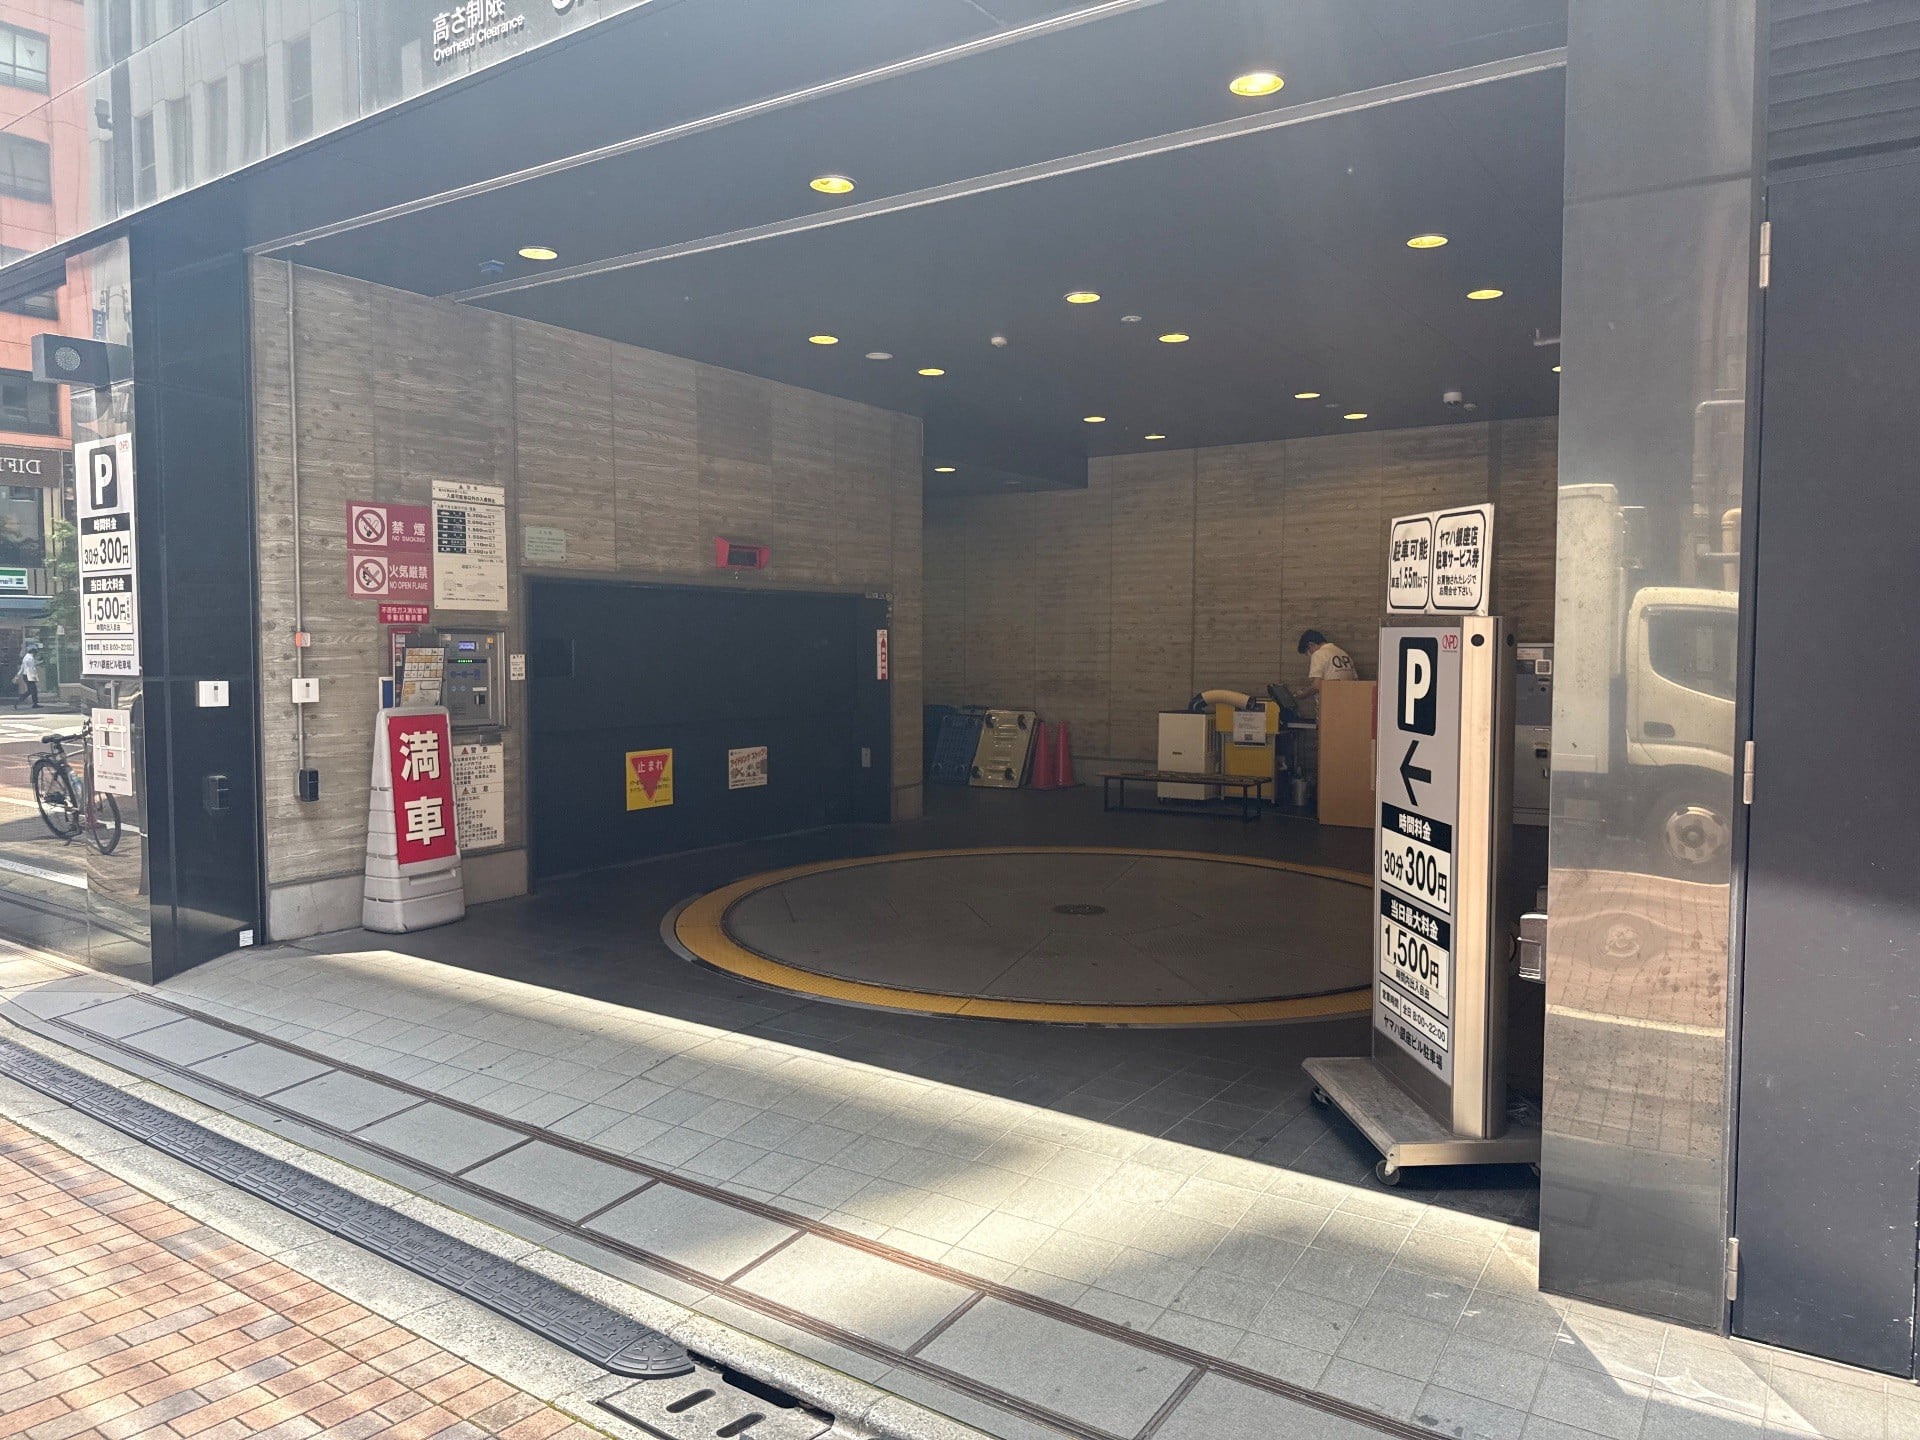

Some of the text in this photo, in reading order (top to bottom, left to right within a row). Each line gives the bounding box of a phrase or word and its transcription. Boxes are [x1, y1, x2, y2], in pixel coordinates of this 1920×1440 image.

[433, 0, 505, 44] 高さ制限
[433, 15, 525, 61] Overhead Clearance
[94, 453, 113, 505] P
[1393, 537, 1428, 562] 駐車可能
[1440, 526, 1479, 547] ヤマハ銀座店
[389, 564, 428, 579] 火気厳禁
[1436, 548, 1479, 569] 駐車サービス券
[90, 577, 125, 592] 当日最大料金
[389, 580, 428, 591] NO OPEN FLAME
[87, 597, 126, 623] 1,500円
[1404, 648, 1431, 725] P
[637, 760, 663, 773] 止まれ
[400, 730, 446, 845] 満車
[1398, 813, 1431, 841] 時間料金
[1391, 899, 1438, 941] 当日最大料金
[1385, 924, 1438, 989] 1,500円
[1383, 1013, 1443, 1071] ヤマハ銀座ビル駐車場
